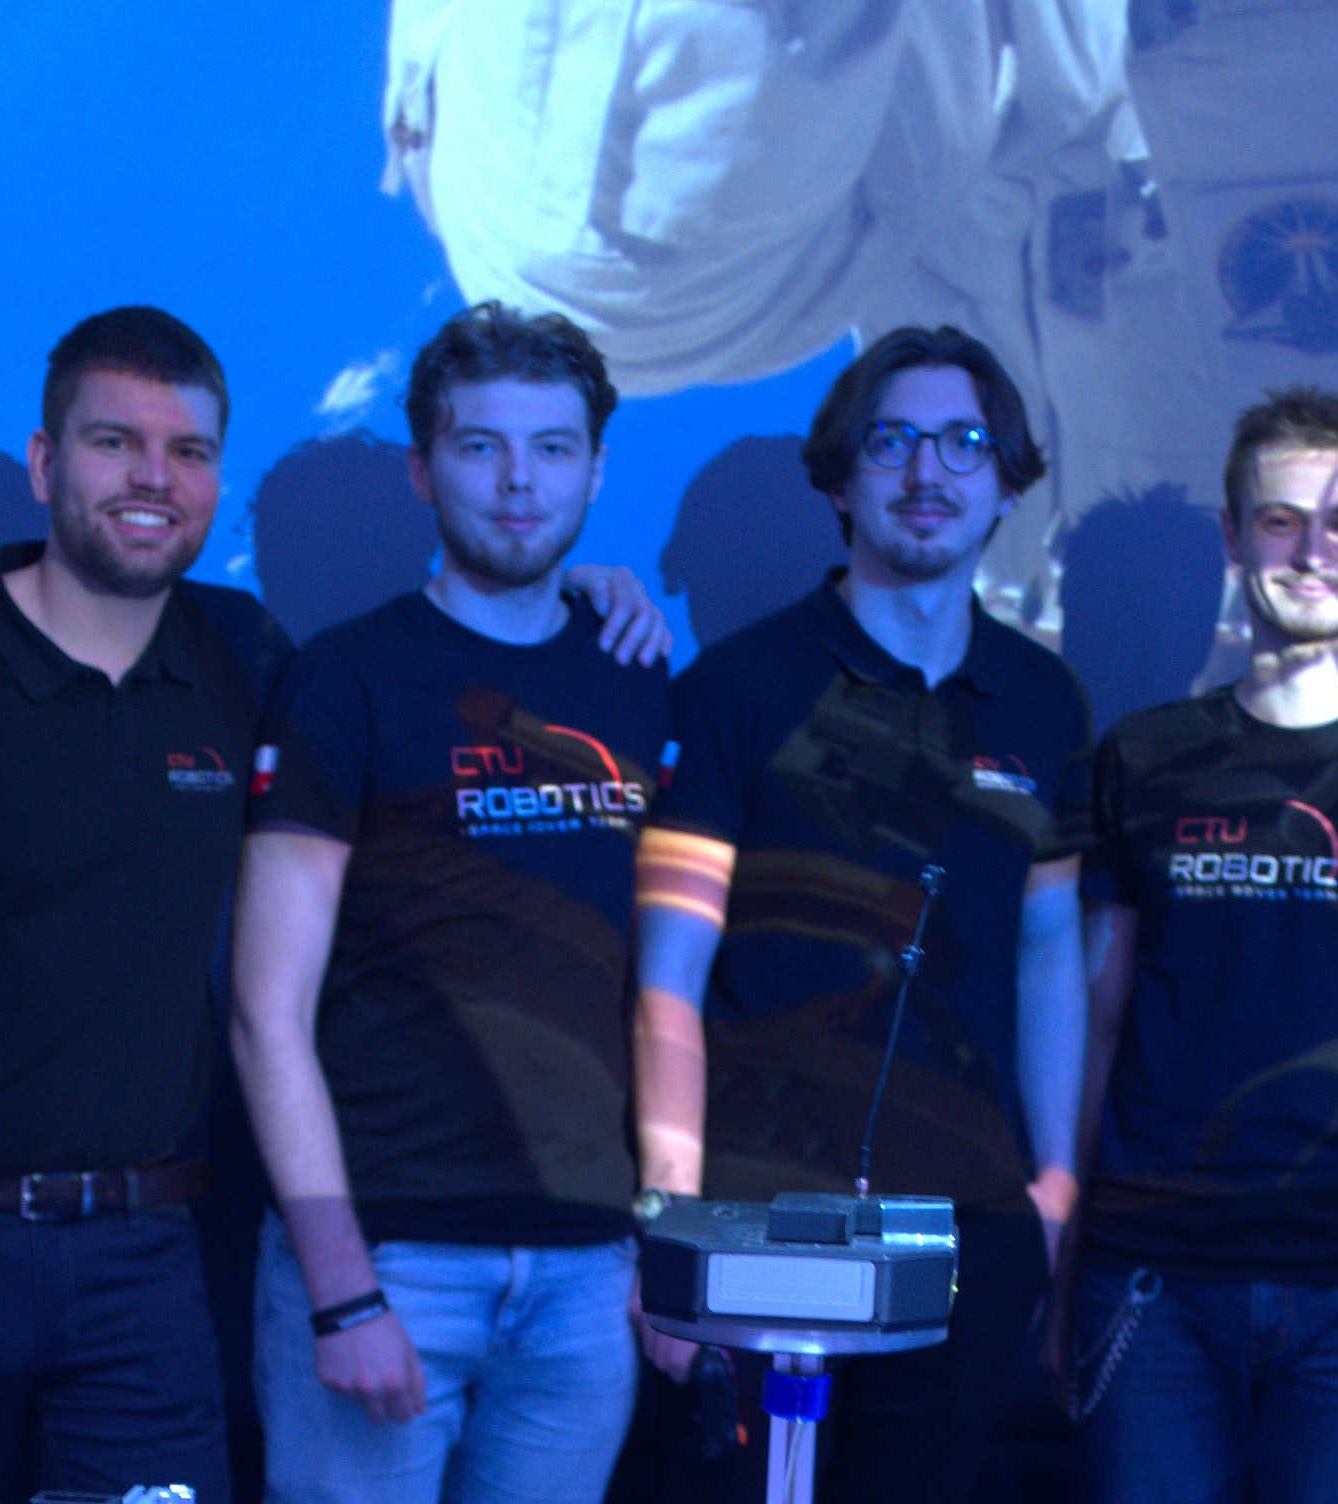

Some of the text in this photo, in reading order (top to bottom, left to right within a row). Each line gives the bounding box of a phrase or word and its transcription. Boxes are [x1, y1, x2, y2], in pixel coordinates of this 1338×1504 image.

[450, 746, 523, 776] CTU
[456, 781, 646, 819] ROBOTICS
[1175, 816, 1247, 843] CTU
